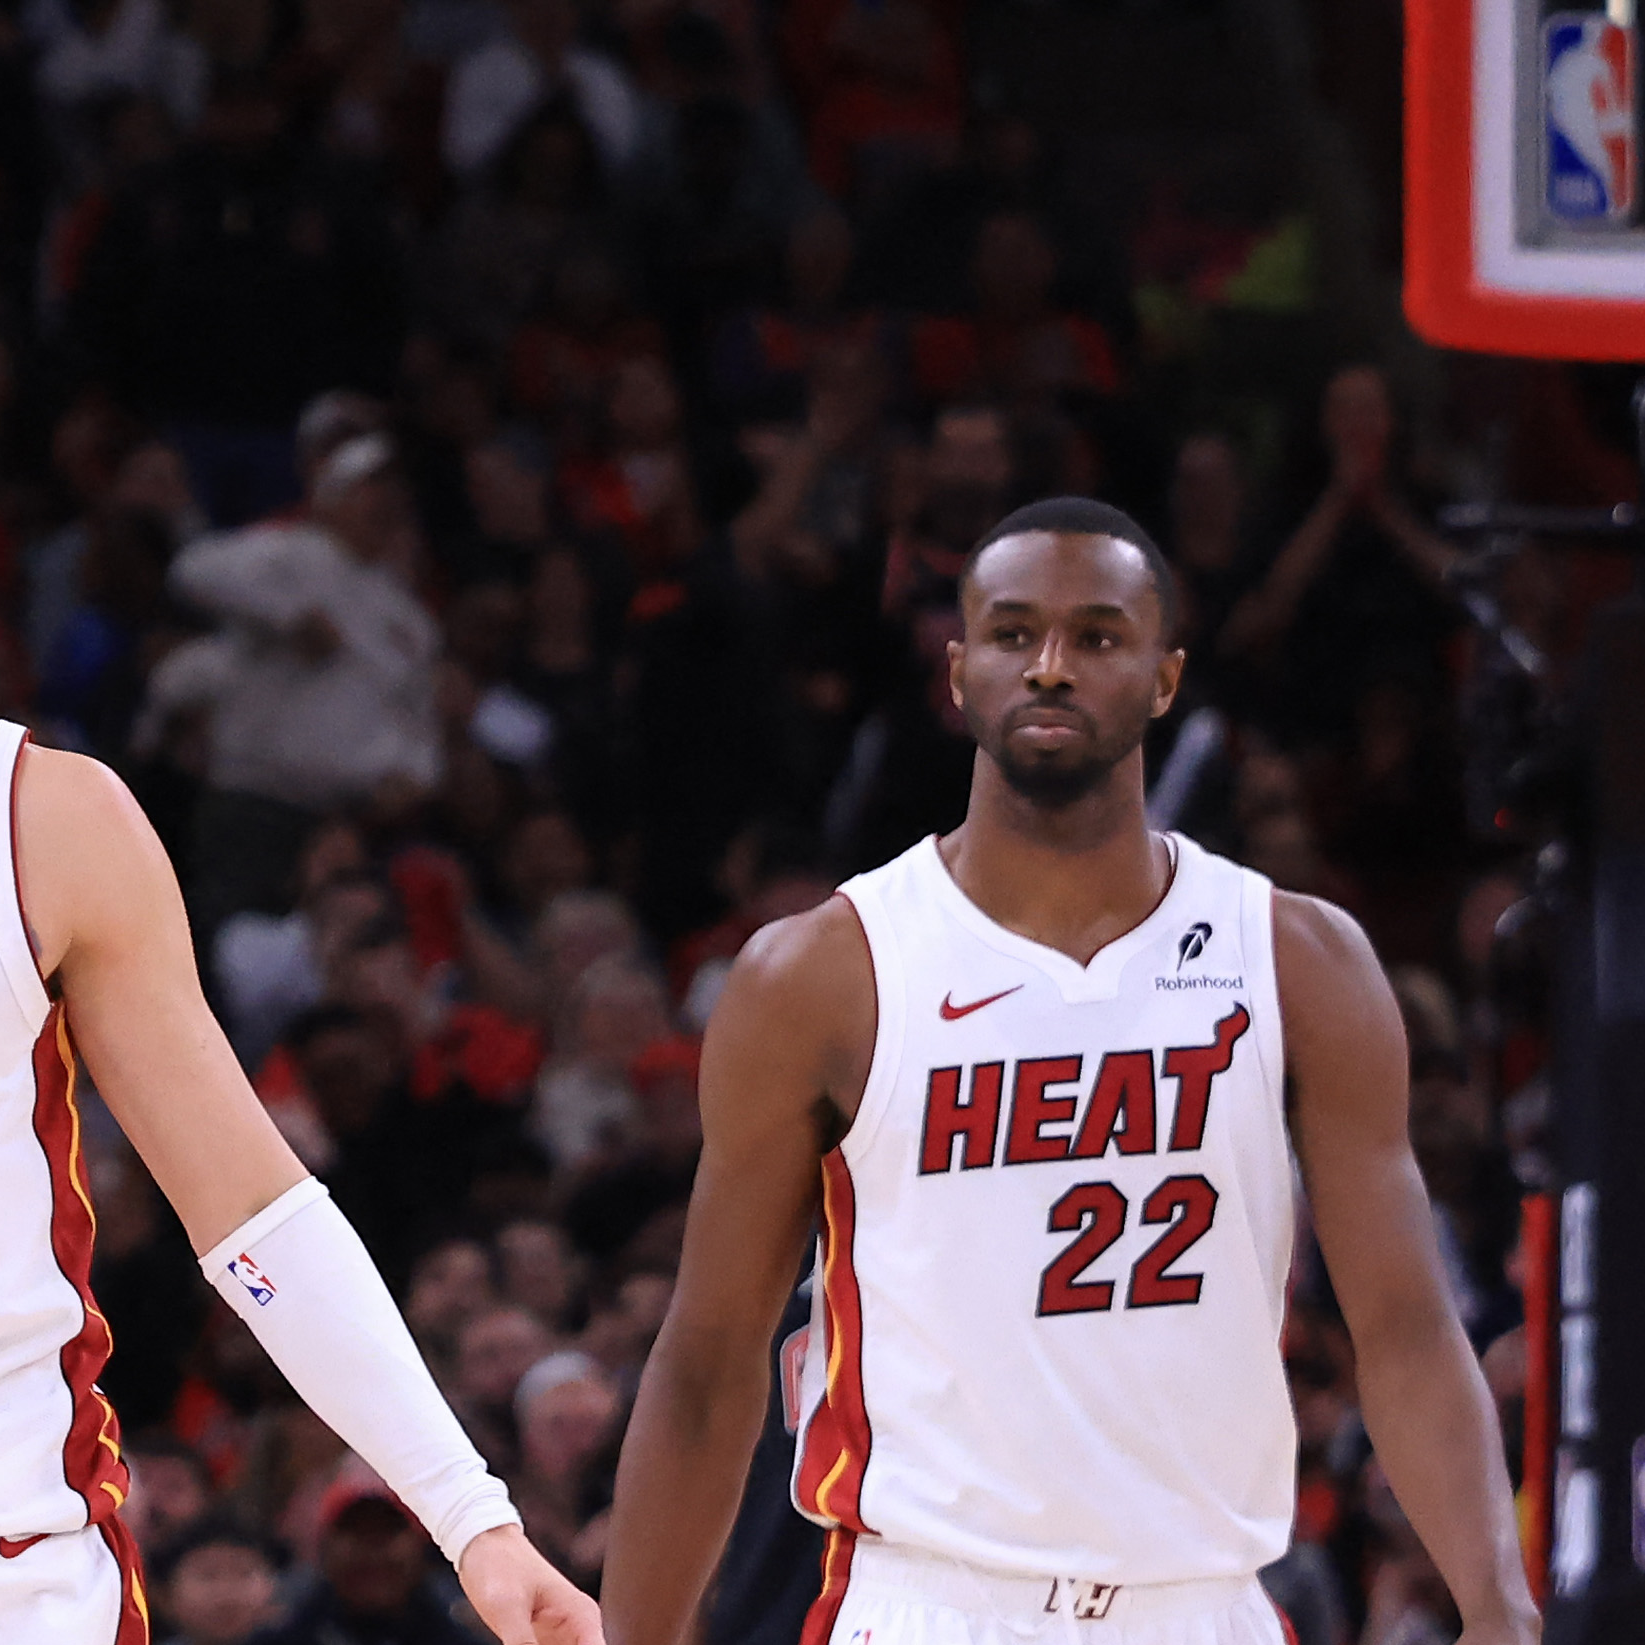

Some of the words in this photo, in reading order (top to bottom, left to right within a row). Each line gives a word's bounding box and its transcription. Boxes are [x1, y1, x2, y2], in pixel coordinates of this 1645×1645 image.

[1155, 974, 1244, 992] Robinhood
[917, 1000, 1251, 1177] HEAT
[1034, 1174, 1220, 1319] 22
